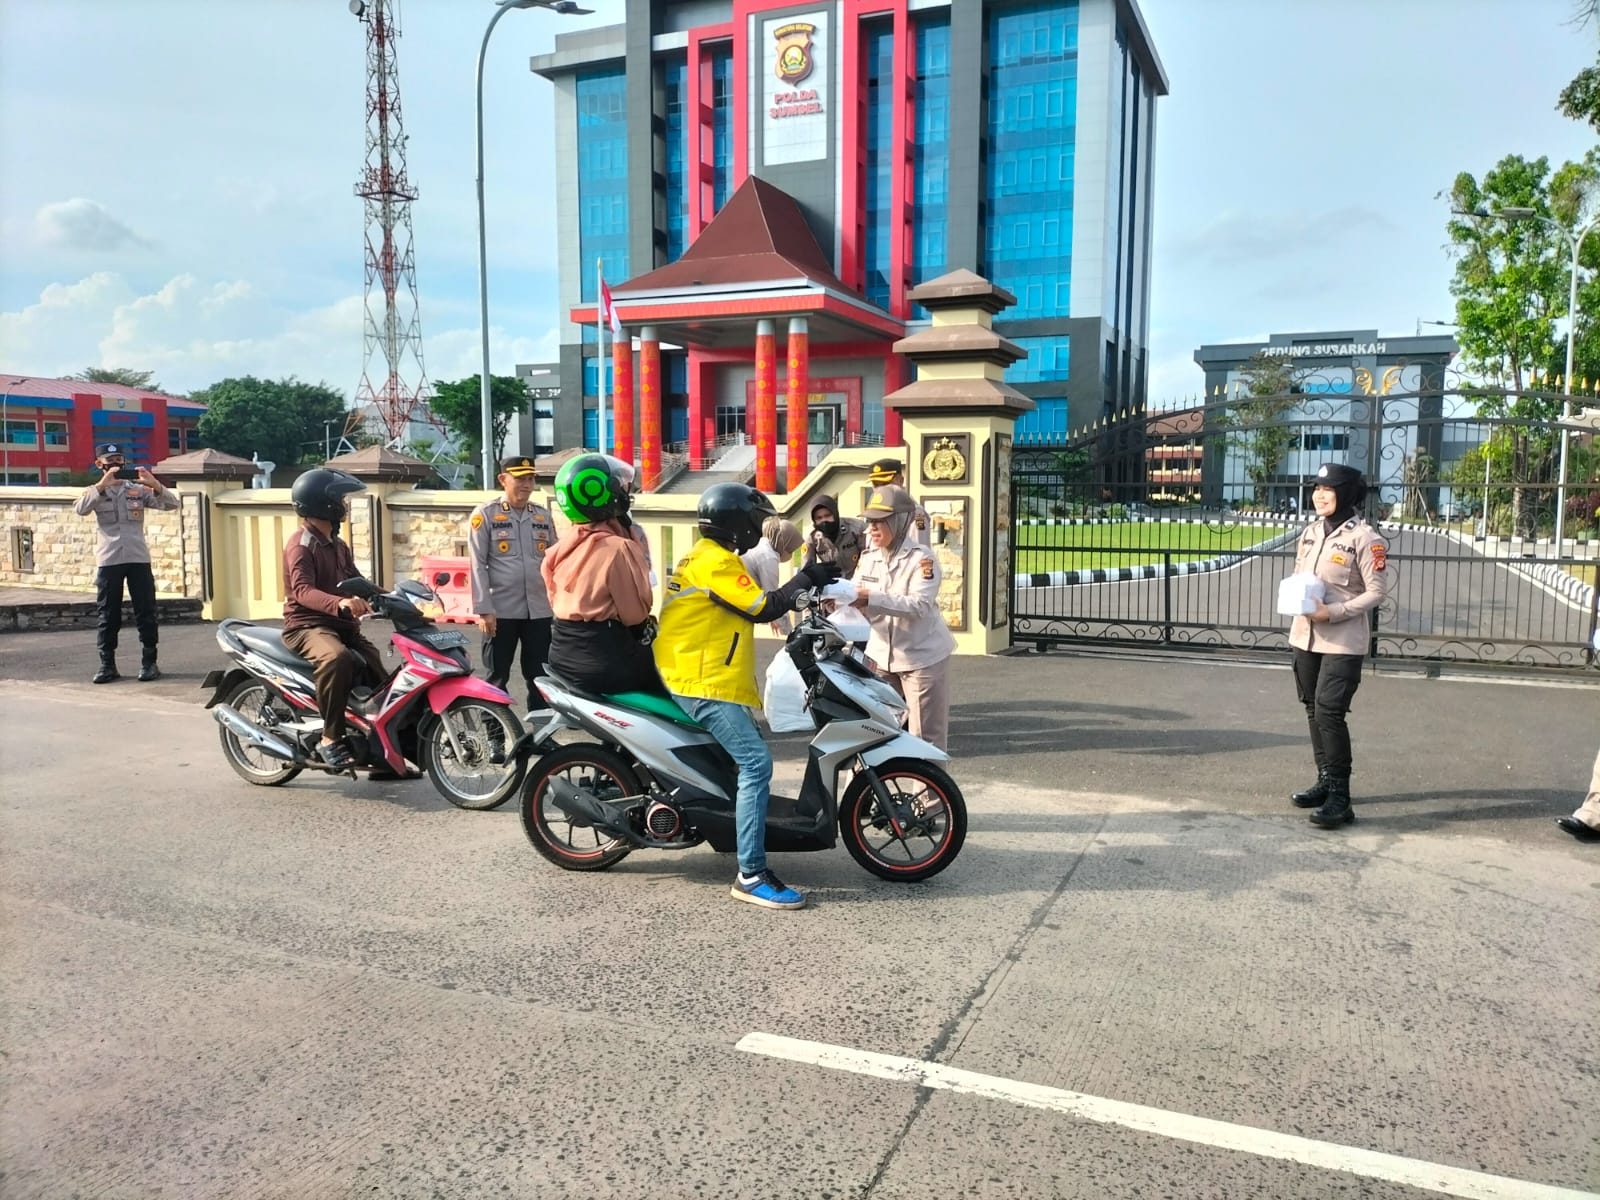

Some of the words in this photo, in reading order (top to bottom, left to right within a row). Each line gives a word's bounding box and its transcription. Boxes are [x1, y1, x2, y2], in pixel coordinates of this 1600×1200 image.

[774, 89, 817, 104] POLDA
[769, 102, 823, 119] SUMSEL
[1331, 542, 1356, 555] POLRI
[861, 723, 885, 736] HONDA
